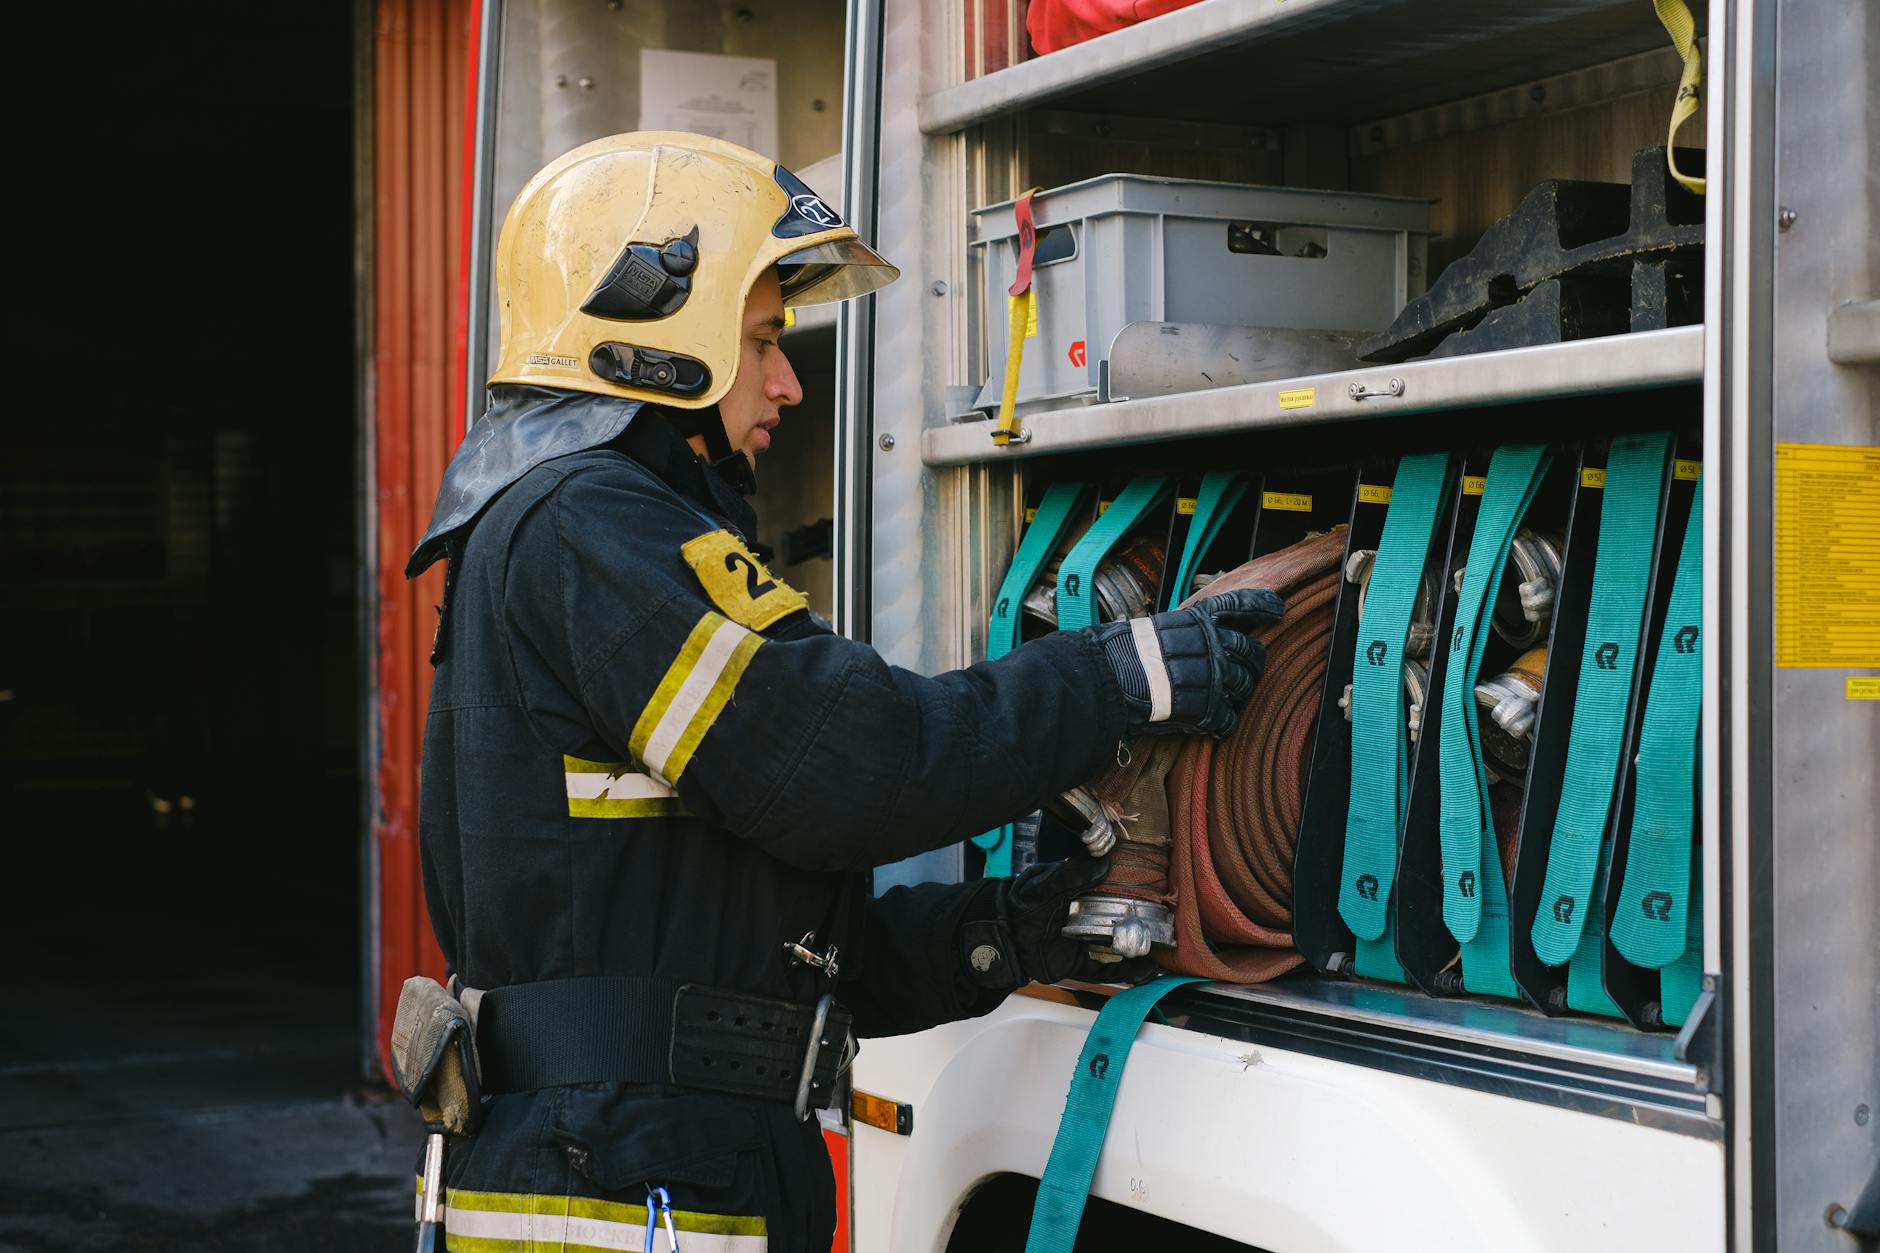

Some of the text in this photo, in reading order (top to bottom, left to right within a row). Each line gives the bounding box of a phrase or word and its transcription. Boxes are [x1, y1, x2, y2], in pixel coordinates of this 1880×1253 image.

[800, 199, 835, 224] 27
[626, 264, 658, 290] MSA
[550, 357, 577, 367] GALLET
[725, 552, 778, 601] 2
